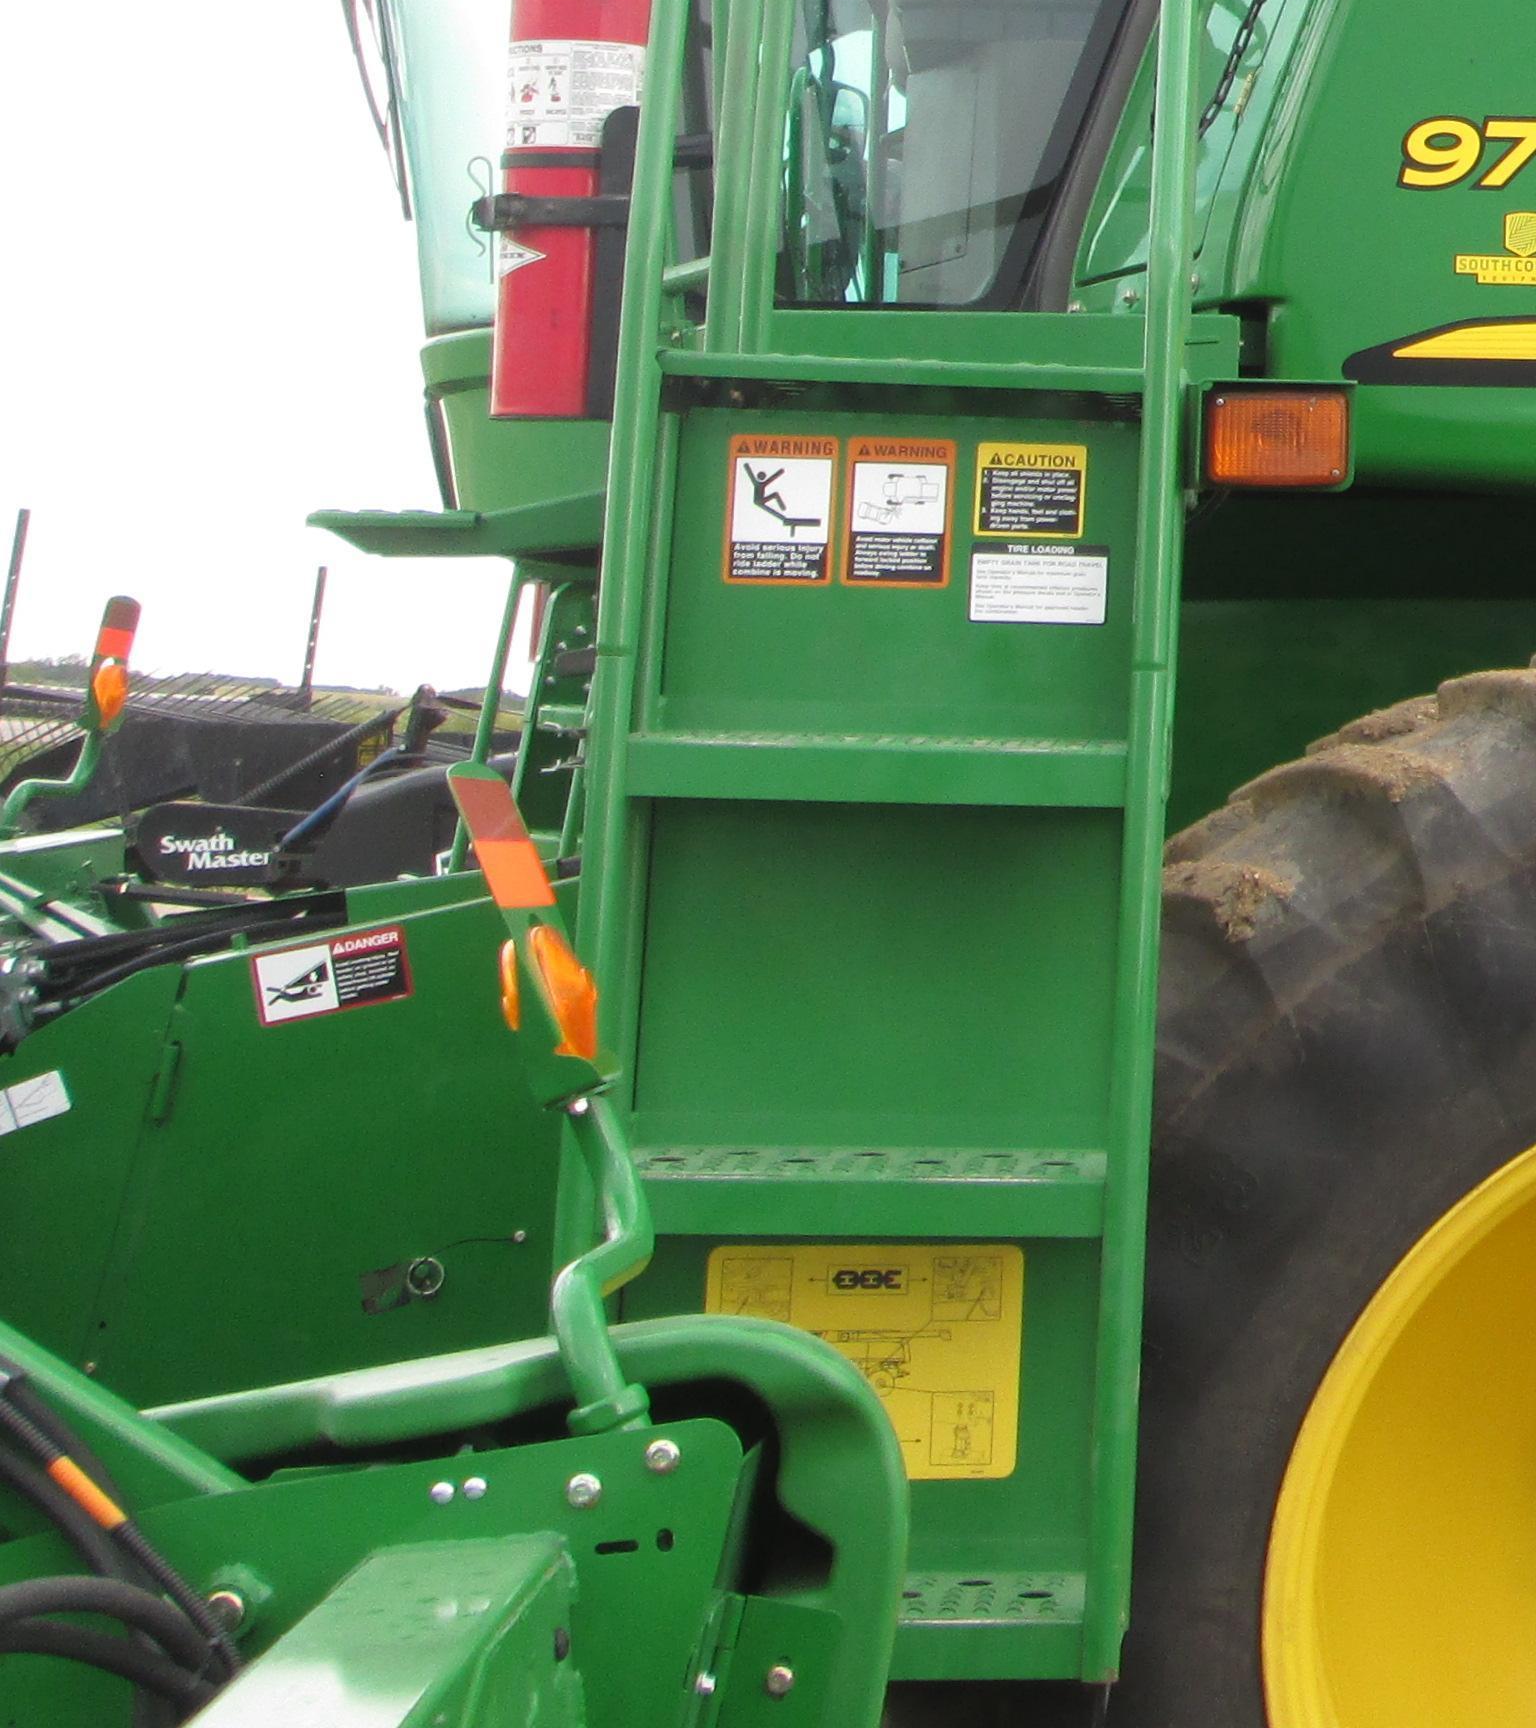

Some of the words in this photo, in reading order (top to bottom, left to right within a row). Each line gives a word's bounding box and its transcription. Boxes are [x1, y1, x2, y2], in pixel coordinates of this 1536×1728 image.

[753, 440, 834, 456] WARNING
[874, 444, 947, 459] WARNING
[1004, 453, 1076, 467] CAUTION
[1007, 544, 1029, 553] TIRE
[1031, 545, 1075, 555] LOADING
[159, 833, 235, 854] Swath
[186, 850, 272, 871] Master
[344, 931, 399, 954] DANGER
